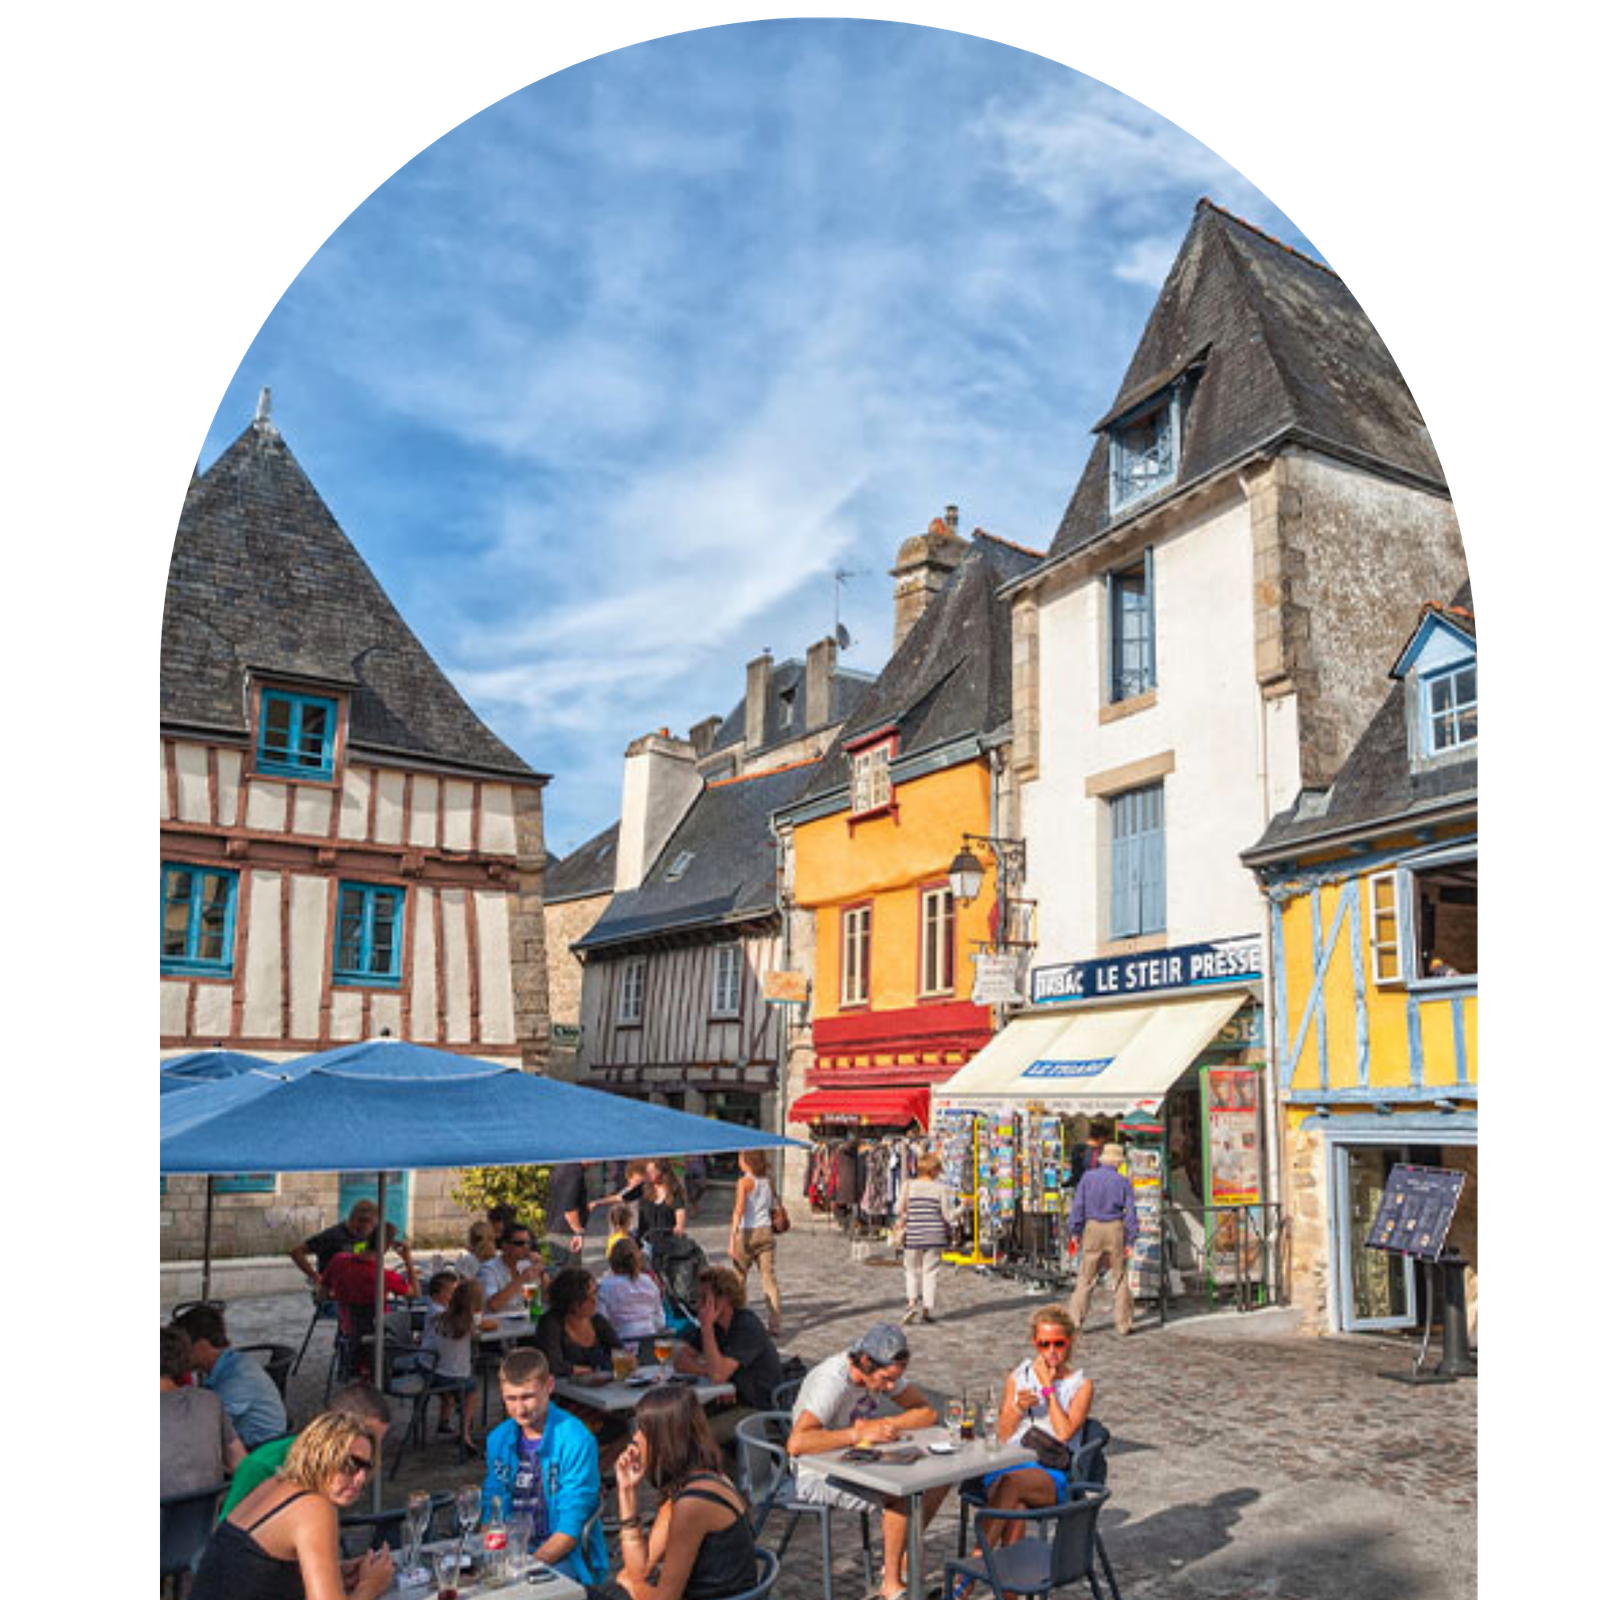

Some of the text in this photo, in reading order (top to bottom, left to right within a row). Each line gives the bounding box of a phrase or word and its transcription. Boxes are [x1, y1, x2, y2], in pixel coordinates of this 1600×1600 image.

[1096, 966, 1118, 992] LE
[1125, 956, 1182, 989] STEIR
[1190, 947, 1261, 979] PRESSE
